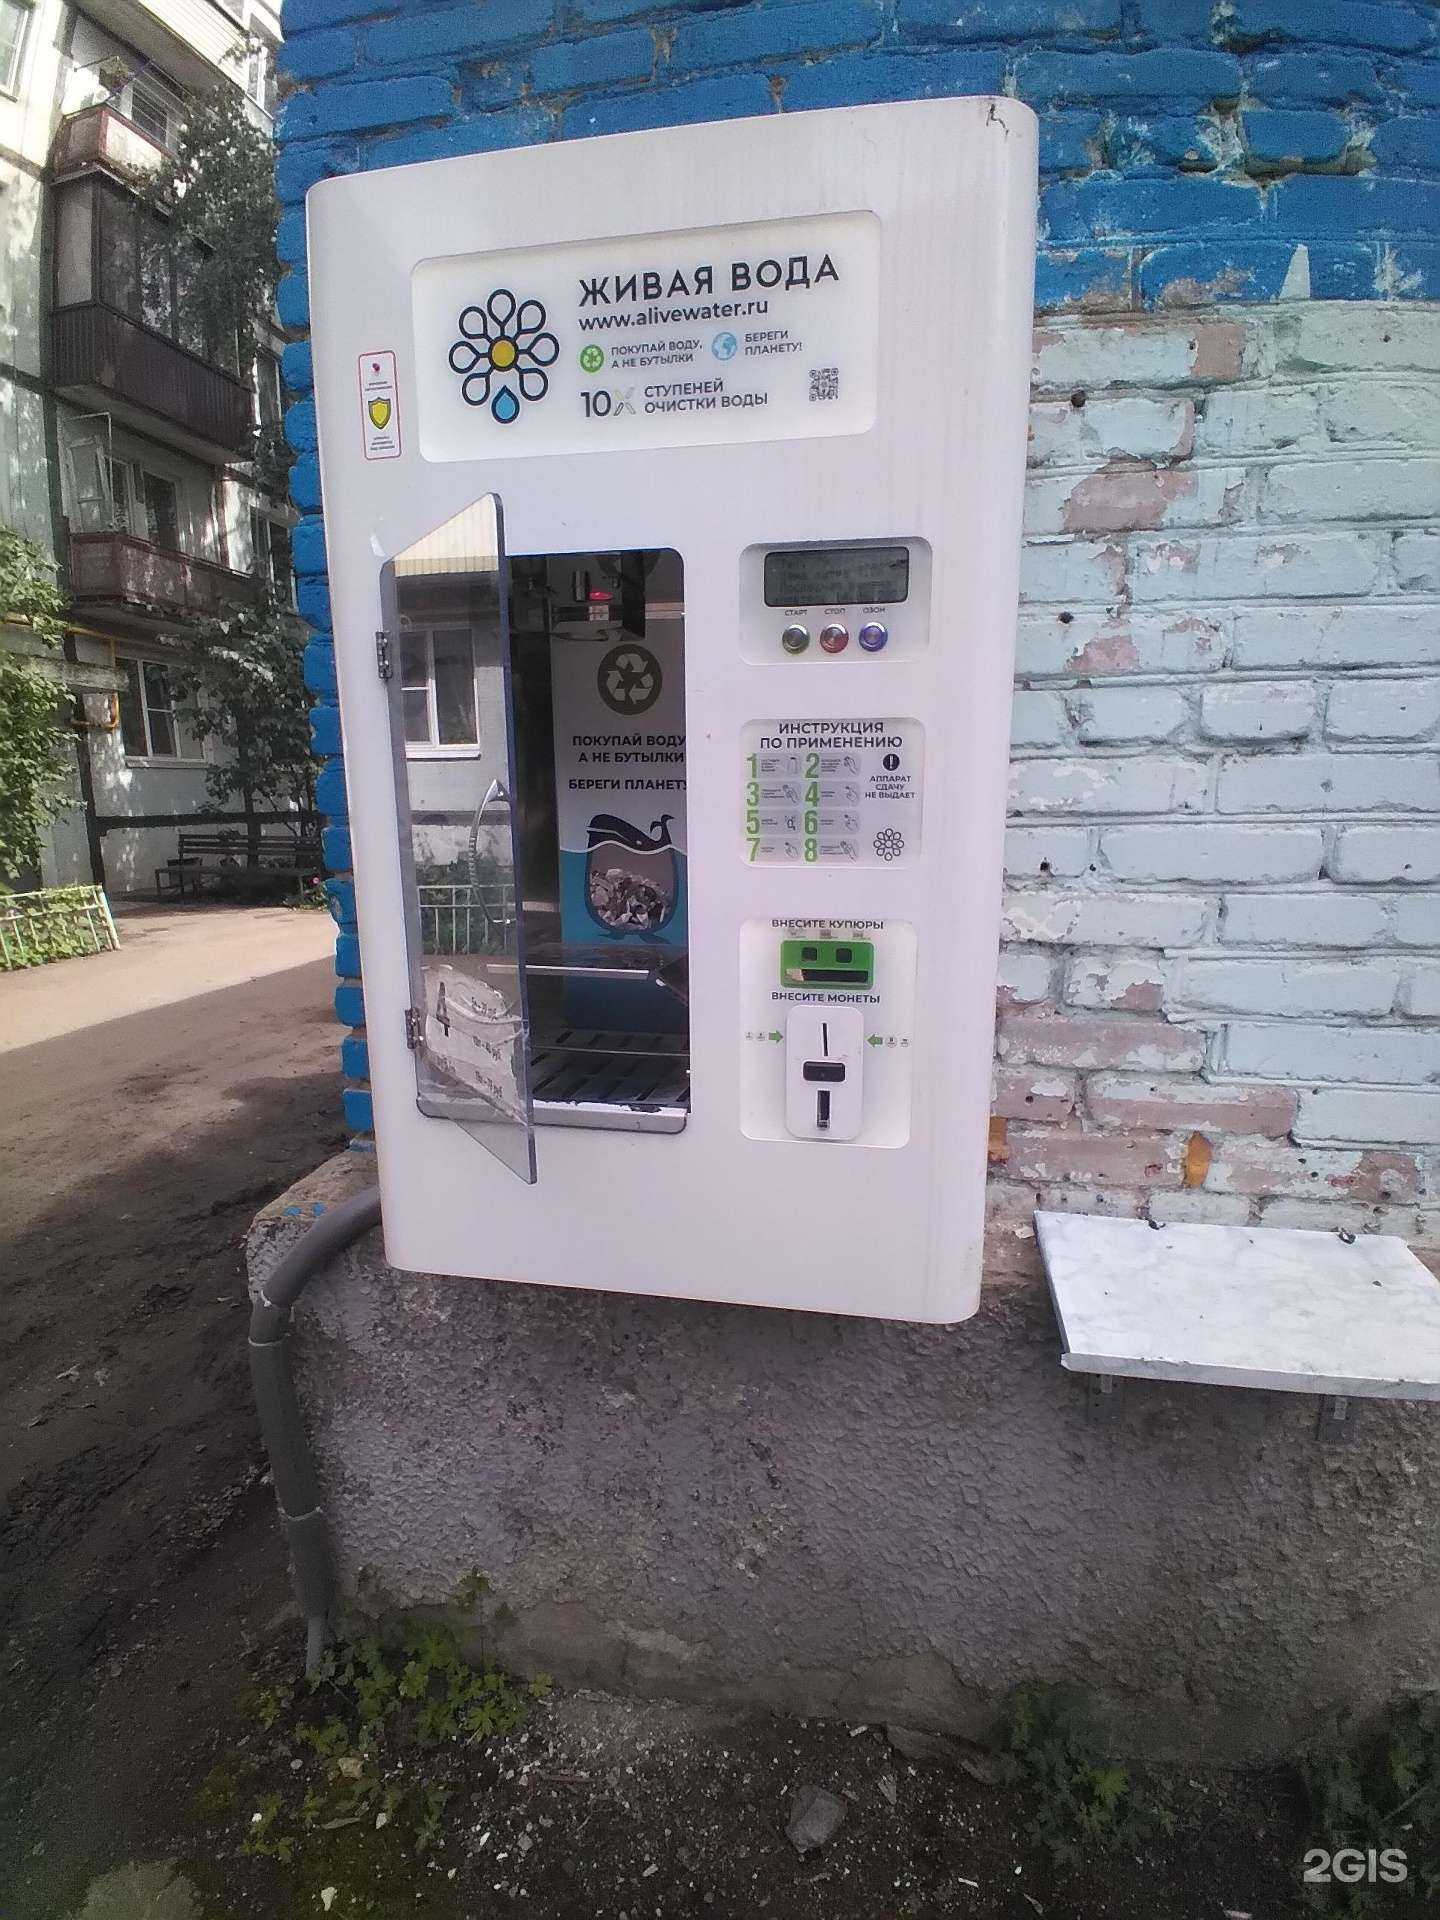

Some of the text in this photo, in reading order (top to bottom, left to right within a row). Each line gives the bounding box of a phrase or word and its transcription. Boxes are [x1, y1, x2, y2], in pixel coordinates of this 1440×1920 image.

[579, 254, 839, 307] ЖИВАЯ ВОДА
[579, 301, 768, 331] www.alivewater.ru
[745, 330, 788, 343] БЕРЕГИ
[611, 341, 666, 356] ПОКУПАЙ
[744, 342, 802, 356] ПЛАНЕТУ!
[611, 354, 694, 369] А НЕ БУТЫЛКИ
[644, 377, 723, 398] СТУПЕНЕЙ
[644, 393, 768, 414] ОЧИСТКИ ВОДЫ
[862, 606, 886, 614] ОЗОН
[779, 722, 884, 735] ИНСТРУКЦИЯ
[572, 732, 687, 748] ПОКУПАЙ ВОДУ
[760, 736, 903, 749] ПО ПРИМЕНЕНИЮ
[578, 752, 684, 763] А НЕ БУТЫЛКИ
[746, 752, 758, 779] 1
[805, 752, 820, 779] 2
[568, 778, 620, 790] БЕРЕГИ
[870, 775, 912, 783] АППАРАТ
[746, 781, 760, 807] 3
[805, 781, 820, 807] 4
[875, 783, 905, 791] СДАЧУ
[746, 809, 760, 835] 5
[804, 810, 818, 835] 6
[746, 837, 760, 862] 7
[804, 838, 818, 862] 8
[772, 919, 884, 930] ВНЕСИТЕ КУПЮРЫ
[771, 992, 880, 1004] ВНЕСИТЕ МОНЕТЫ
